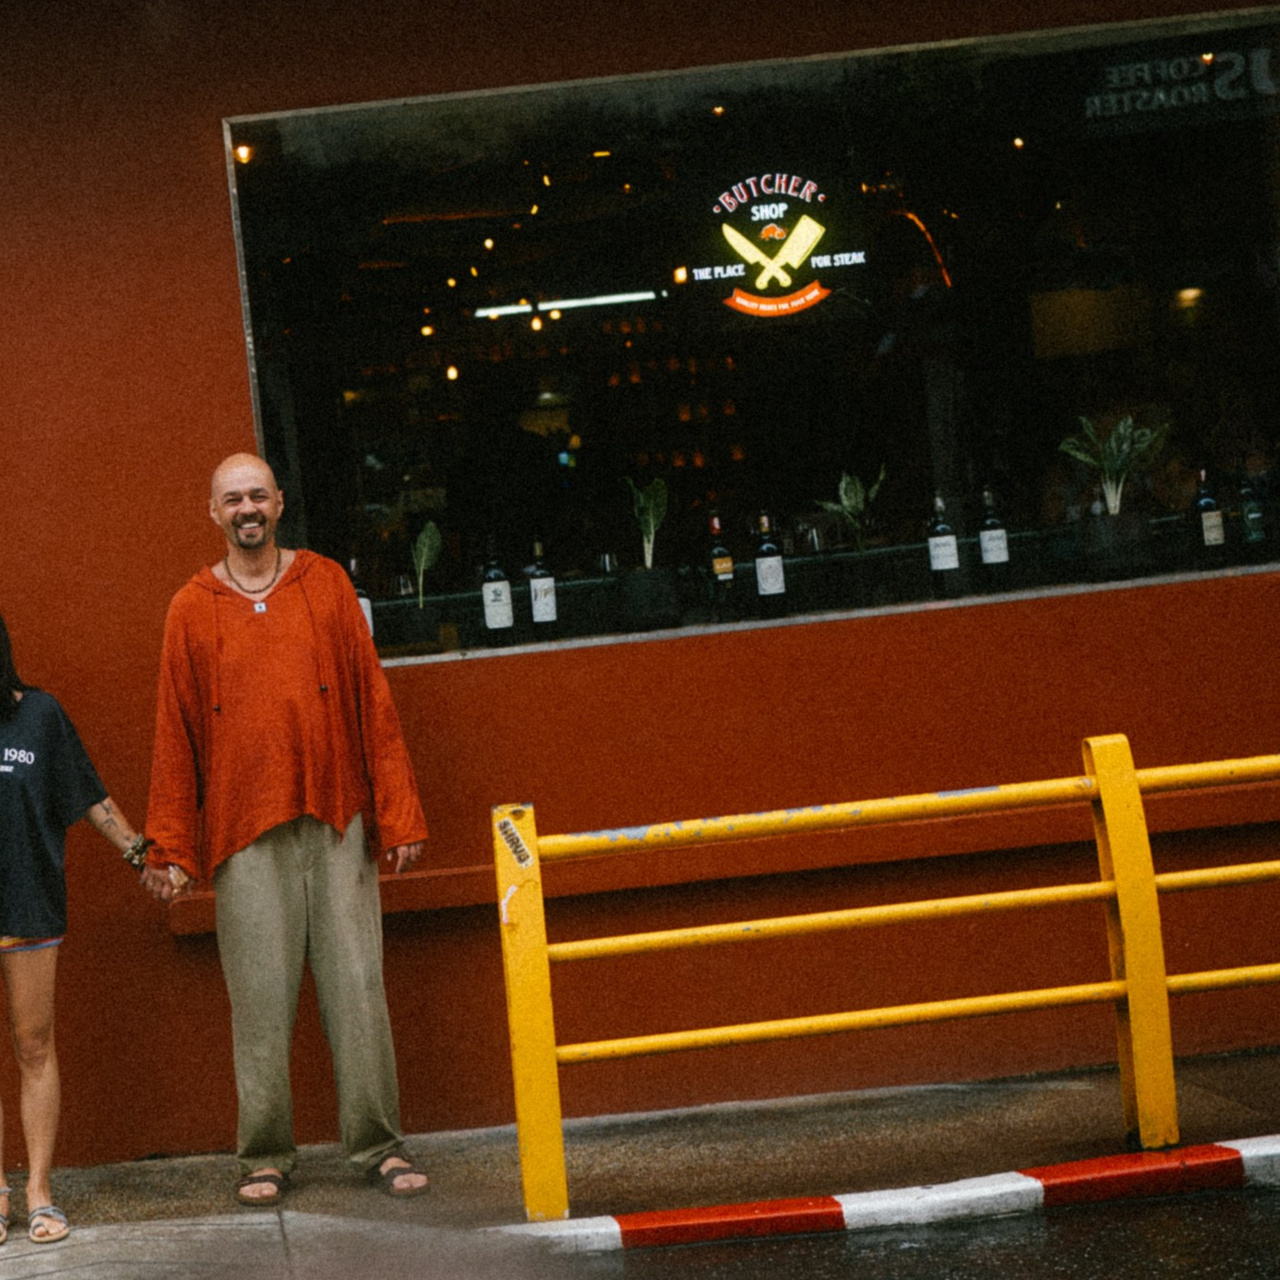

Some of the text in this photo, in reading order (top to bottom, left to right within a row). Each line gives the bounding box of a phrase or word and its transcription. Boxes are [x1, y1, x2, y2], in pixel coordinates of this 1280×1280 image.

[718, 173, 818, 212] BUTCHER
[750, 203, 788, 221] SHOP
[811, 251, 866, 268] FOR STEAK
[692, 264, 746, 280] THE PLACE
[4, 748, 35, 764] 1980
